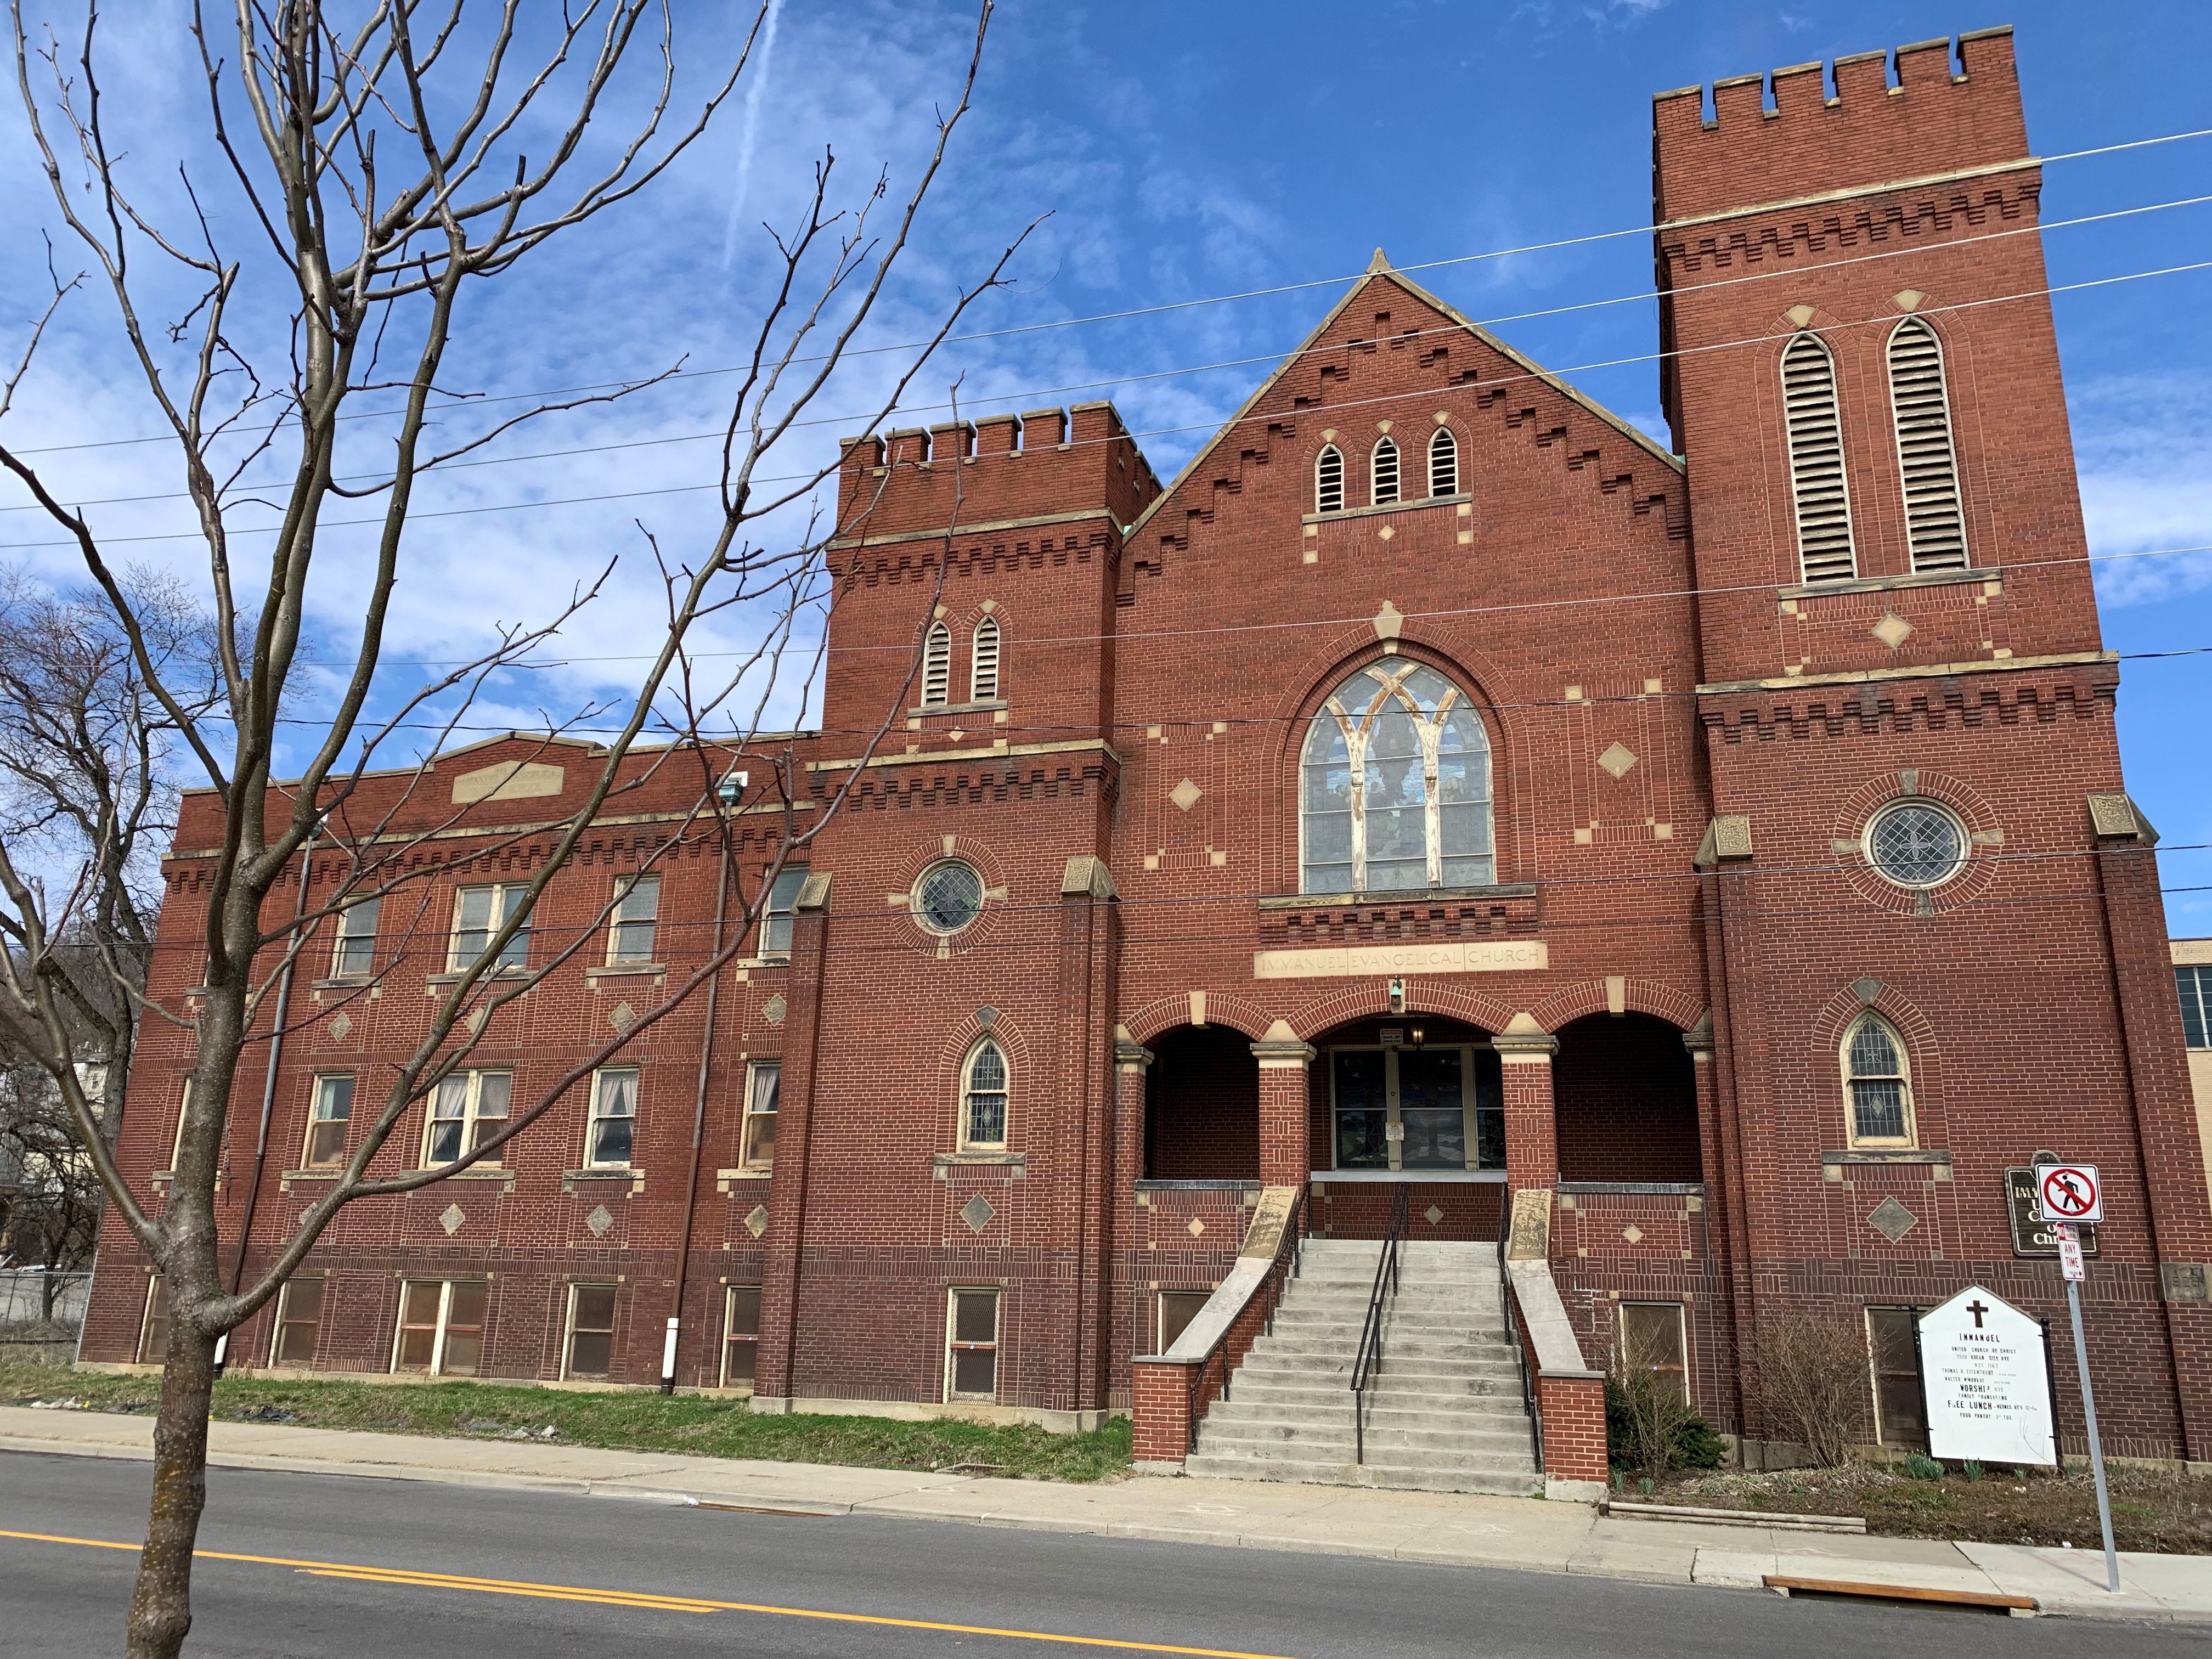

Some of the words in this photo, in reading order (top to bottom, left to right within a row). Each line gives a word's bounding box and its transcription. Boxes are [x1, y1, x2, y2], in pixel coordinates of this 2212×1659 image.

[1262, 956, 1346, 970] IMMANUEL
[1352, 951, 1461, 967] EVANGELICAL
[1468, 949, 1539, 963] CHURCH
[2057, 1226, 2065, 1237] NO
[2033, 1233, 2058, 1244] Chr
[2065, 1244, 2075, 1254] ANY
[2066, 1257, 2079, 1268] TIME
[1948, 1400, 1965, 1408] FEE
[1970, 1401, 1992, 1410] LUNCH
